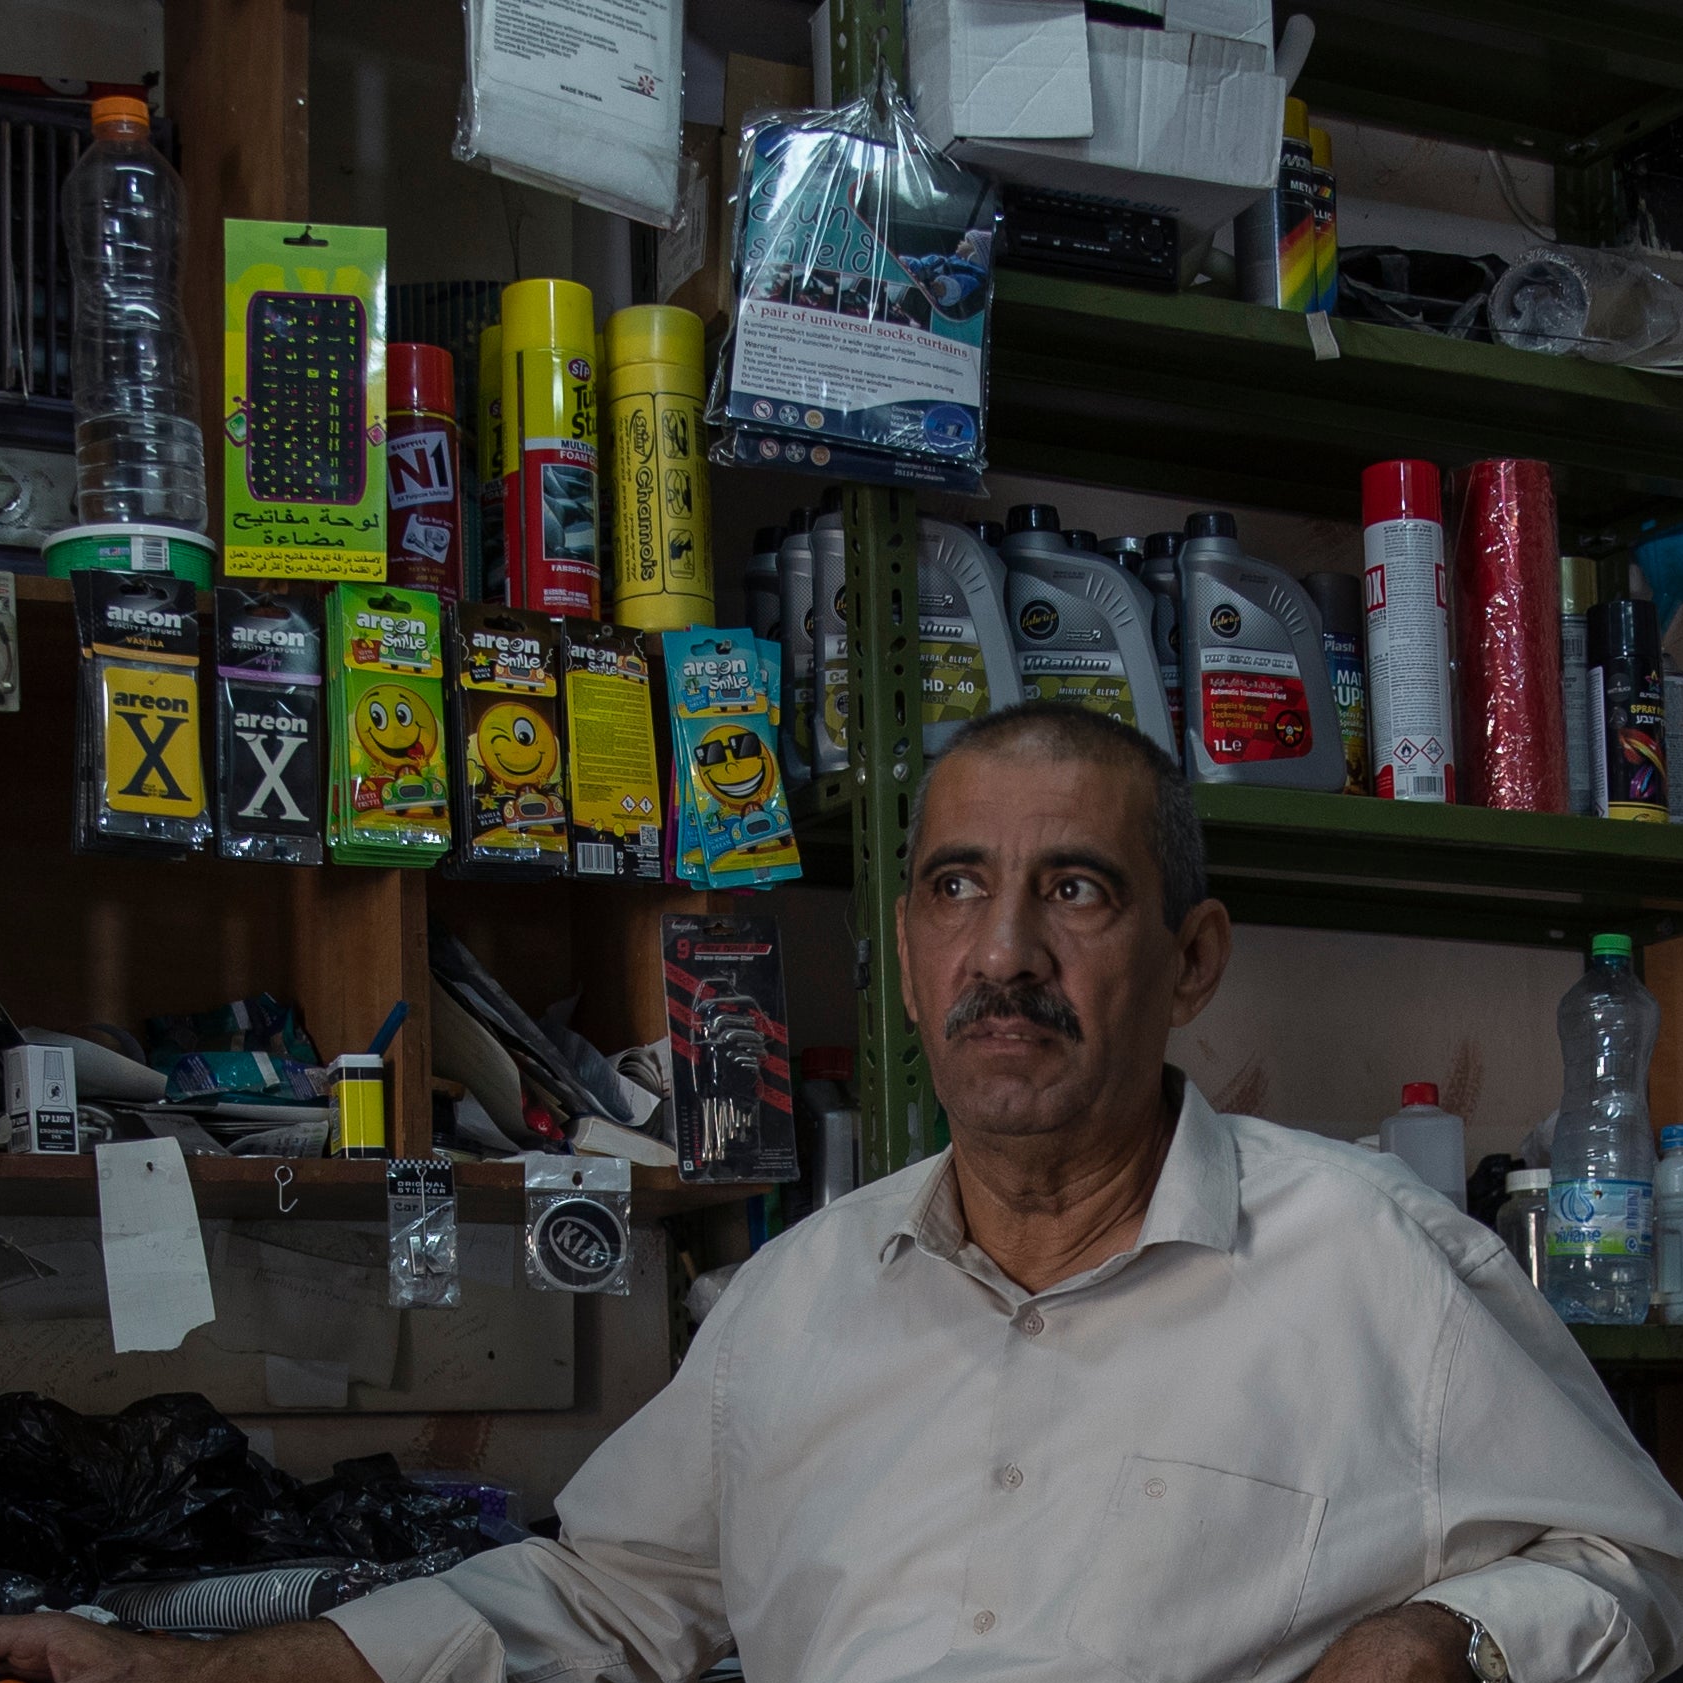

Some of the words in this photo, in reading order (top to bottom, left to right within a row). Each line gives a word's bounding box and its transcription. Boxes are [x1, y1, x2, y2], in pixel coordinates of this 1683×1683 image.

[560, 85, 575, 93] MADE
[584, 91, 602, 101] CHINA
[748, 229, 874, 274] shield
[743, 328, 756, 336] Easy
[767, 332, 795, 342] assemble
[746, 303, 755, 313] A
[761, 305, 788, 320] pair
[792, 309, 806, 322] of
[810, 313, 872, 334] universal
[876, 325, 912, 342] socks
[916, 337, 967, 357] curtains
[780, 327, 804, 336] product
[744, 341, 776, 352] Warning
[572, 360, 590, 378] STP
[560, 450, 587, 462] FOAM
[233, 509, 309, 529] مفاتيح
[319, 509, 379, 532] لوحة
[634, 465, 656, 582] Chamois
[263, 530, 345, 547] مضاءة
[107, 604, 182, 629] areon
[356, 611, 426, 635] areon
[141, 626, 183, 637] PERFUMES
[232, 625, 305, 647] areon
[125, 636, 165, 648] VANILLA
[381, 633, 427, 650] Smile
[472, 632, 541, 654] areon
[497, 652, 541, 670] Smile
[570, 644, 617, 663] areon
[948, 655, 973, 664] BLEND
[588, 661, 617, 675] Smile
[683, 659, 747, 676] areon
[1023, 655, 1111, 673] Titanium
[709, 676, 750, 691] Smile
[922, 680, 944, 692] HD
[957, 681, 975, 695] 40
[1058, 687, 1093, 697] MINERAL
[1095, 687, 1121, 697] BLEND
[113, 690, 189, 713] areon
[1210, 689, 1239, 697] Automatic
[1240, 690, 1273, 699] Transmission
[1211, 711, 1248, 720] Technology
[1630, 705, 1656, 714] SPRAY
[235, 712, 309, 733] areon
[1211, 721, 1223, 729] Top
[115, 711, 192, 801] X
[236, 731, 310, 822] X
[676, 938, 691, 960] 9
[40, 1115, 50, 1123] YP
[52, 1115, 71, 1124] LION
[393, 1203, 416, 1213] Car
[555, 1222, 601, 1267] KIA
